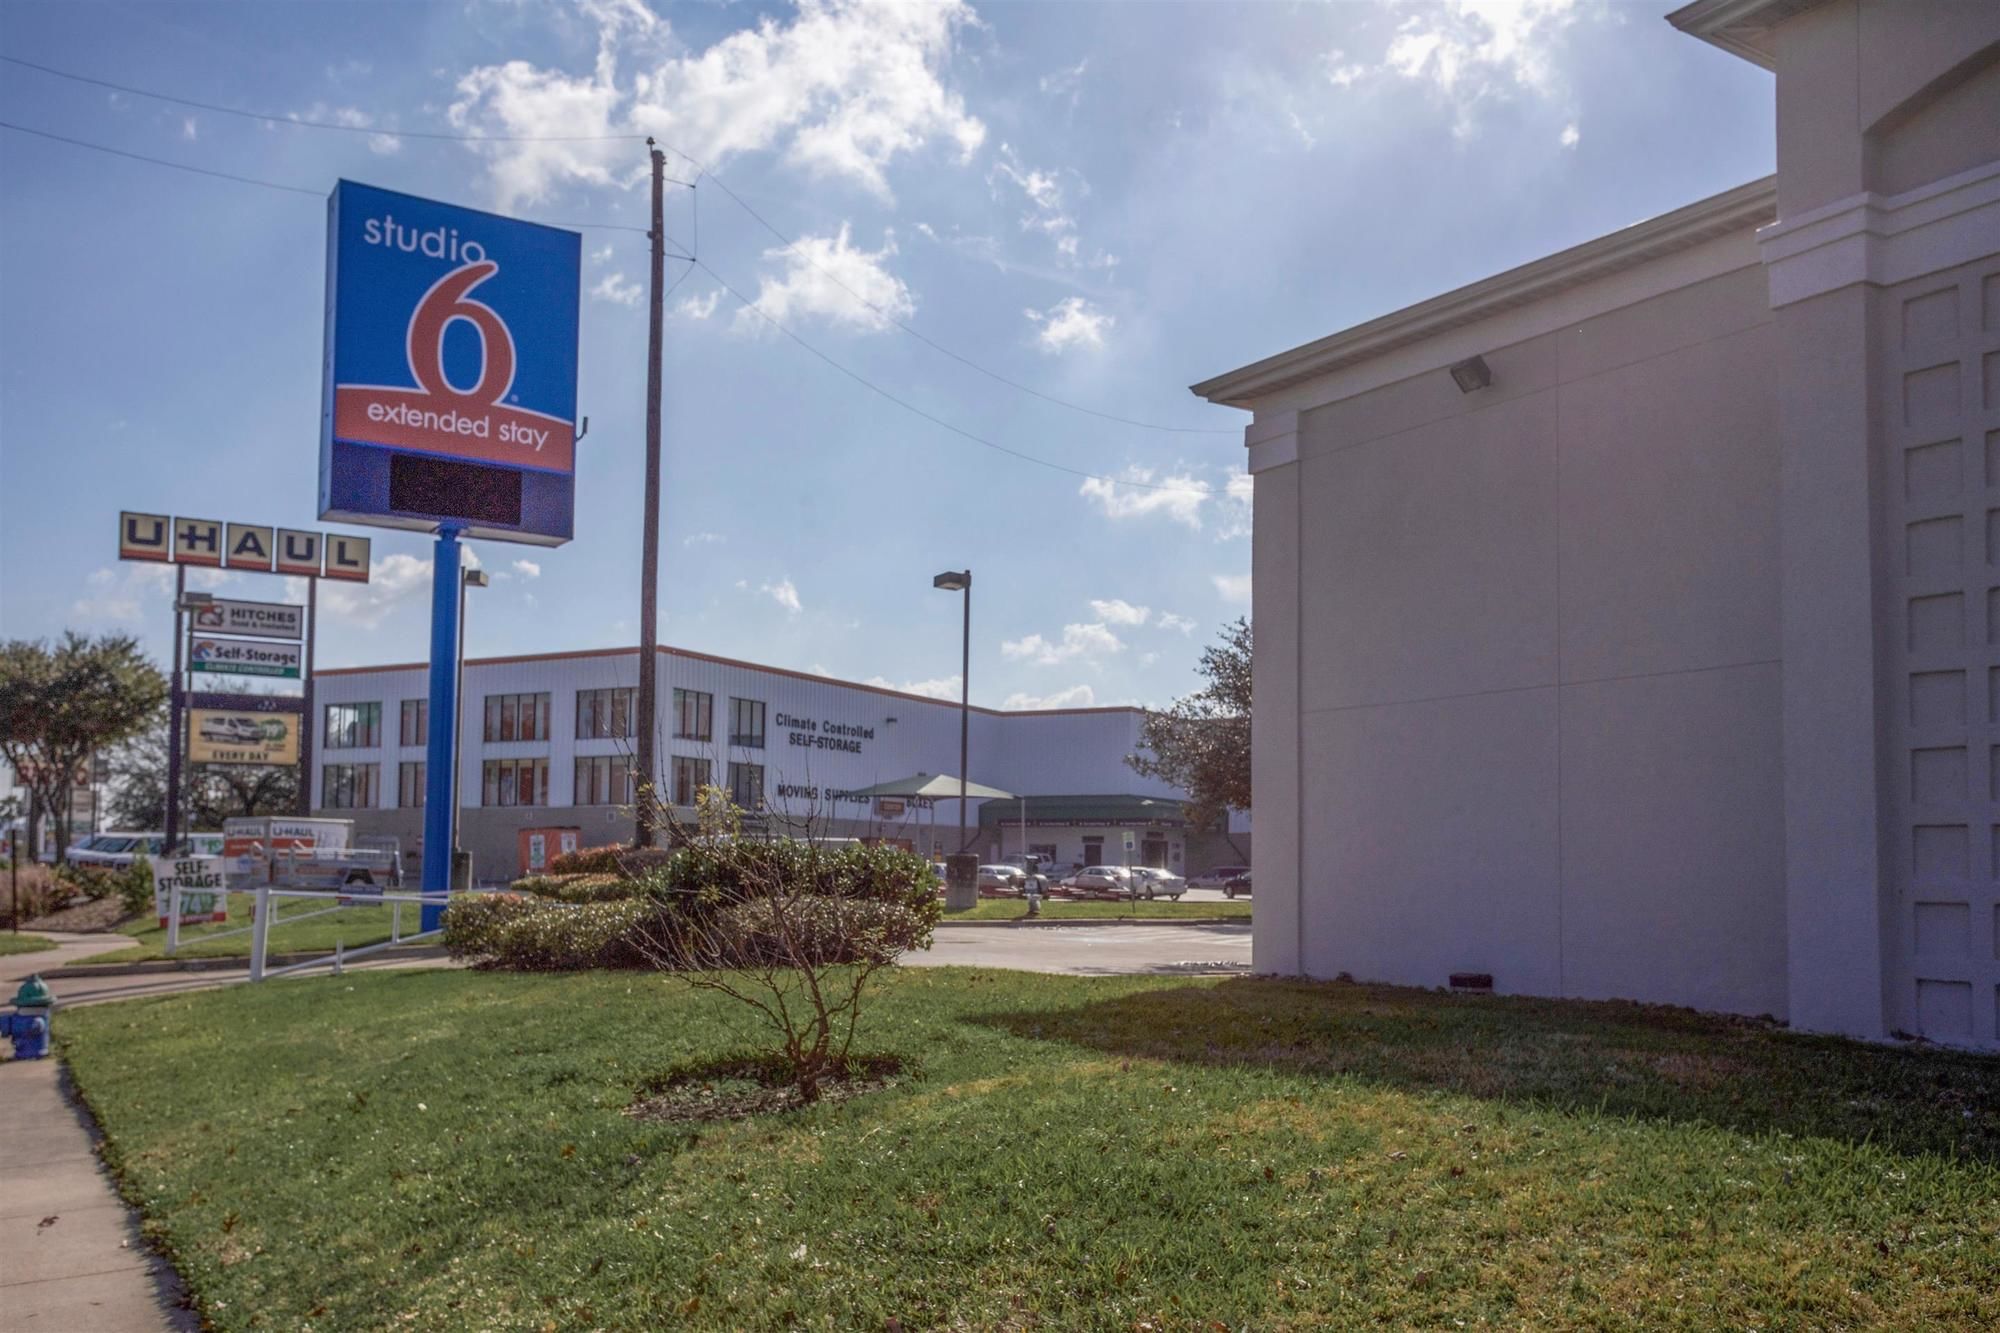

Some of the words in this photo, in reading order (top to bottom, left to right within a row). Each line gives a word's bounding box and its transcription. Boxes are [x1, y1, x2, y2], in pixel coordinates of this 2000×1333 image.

[364, 215, 486, 265] studio
[406, 260, 516, 405] 6
[367, 402, 490, 438] extended
[499, 423, 549, 451] stay
[230, 608, 296, 623] HITCHES
[215, 646, 296, 665] Self-Storage
[776, 713, 817, 730] Climate
[823, 721, 874, 739] Controlled
[789, 732, 862, 753] SELF-STORAGE
[778, 784, 818, 799] MOVING
[175, 860, 209, 875] SELF-
